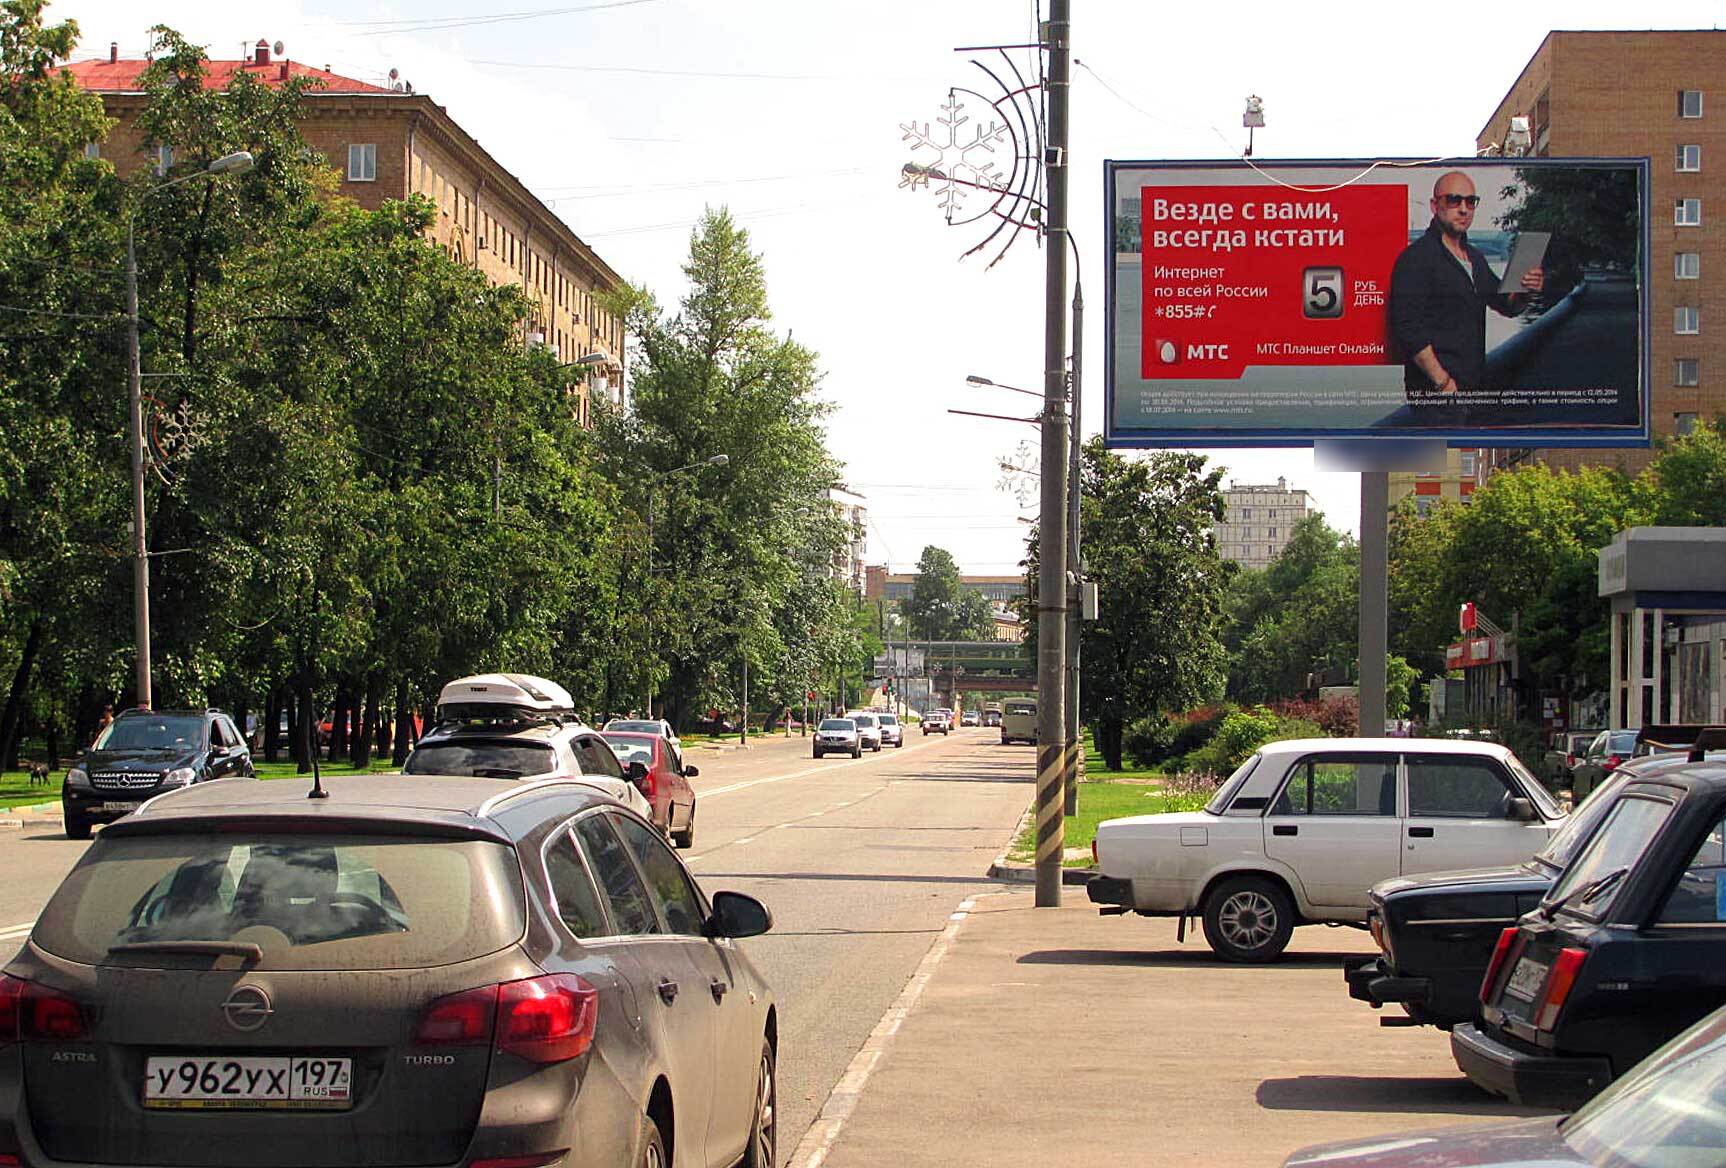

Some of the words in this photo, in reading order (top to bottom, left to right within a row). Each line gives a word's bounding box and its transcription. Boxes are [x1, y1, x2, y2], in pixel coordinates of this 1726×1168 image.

[1153, 198, 1234, 225] Везде
[1241, 202, 1256, 220] с
[1263, 202, 1339, 223] вами,
[1153, 229, 1247, 252] всегда
[1254, 229, 1345, 247] кстати
[1154, 266, 1225, 280] Интернет
[1154, 287, 1173, 297] по
[1177, 284, 1211, 297] всей
[1216, 284, 1268, 297] России
[1309, 275, 1337, 310] 5
[1354, 281, 1377, 291] РУБ
[1354, 294, 1384, 306] ДЕНЬ
[1187, 344, 1229, 360] МТС
[1256, 343, 1282, 354] МТС
[1283, 343, 1336, 354] Планшет
[1339, 343, 1384, 354] Онлайн
[51, 1051, 97, 1062] ASTRA
[404, 1056, 455, 1065] TURBO
[294, 1060, 342, 1086] 197
[303, 1087, 328, 1096] RUS
